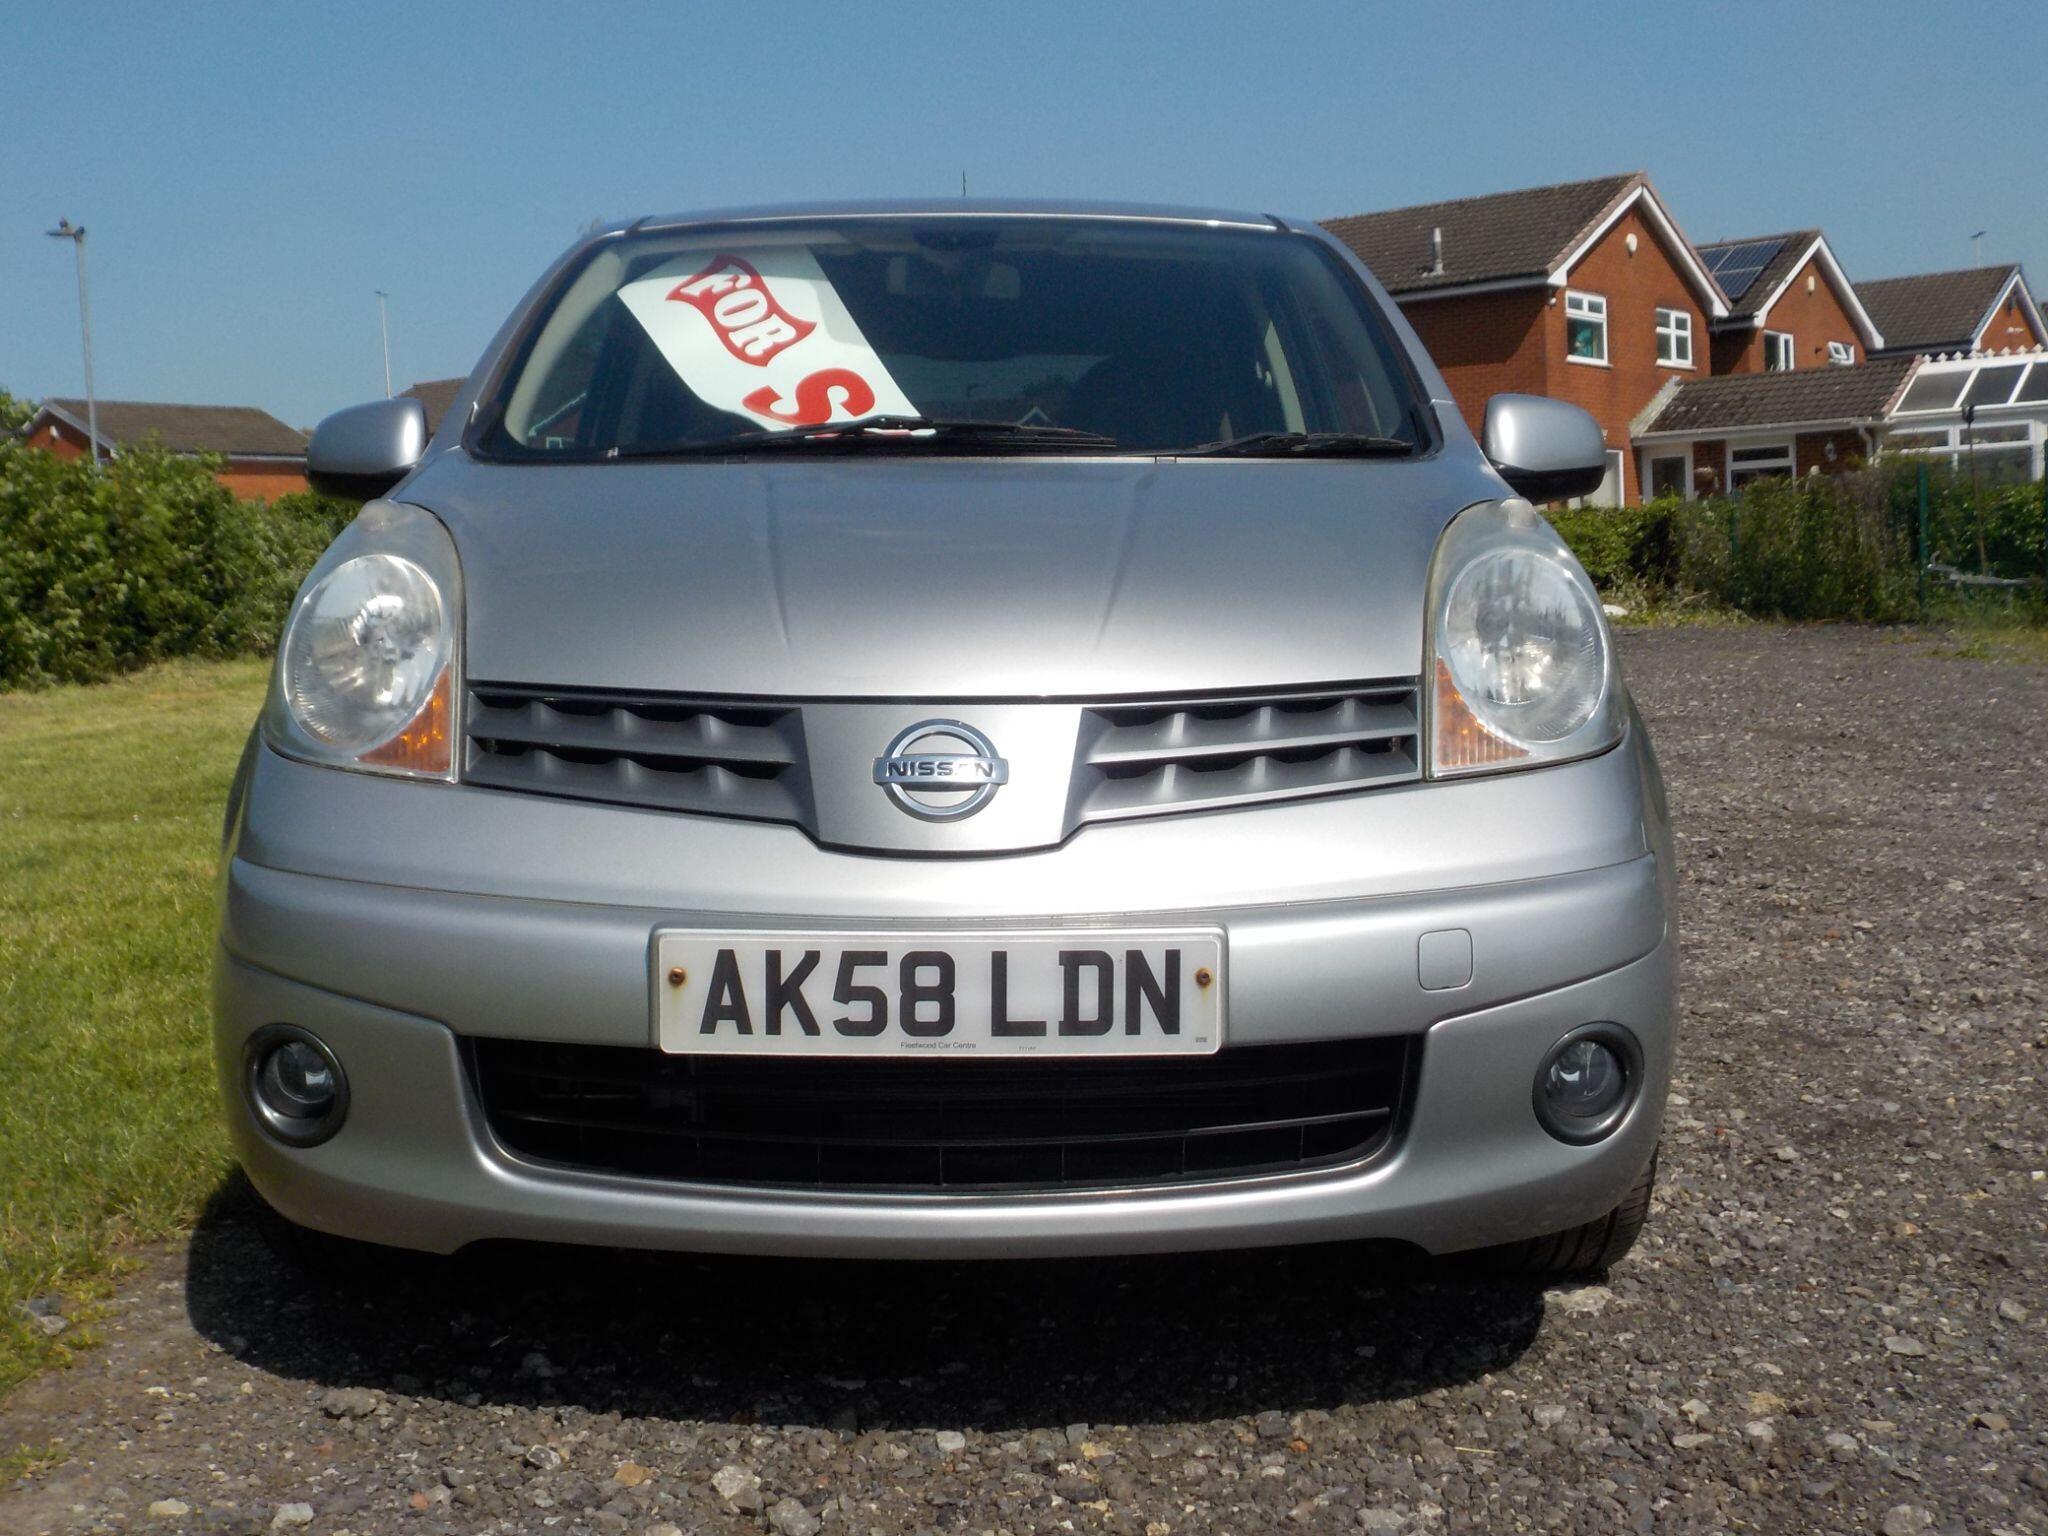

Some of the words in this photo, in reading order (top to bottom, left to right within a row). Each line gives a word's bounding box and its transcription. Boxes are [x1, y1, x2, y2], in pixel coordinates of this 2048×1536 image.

[680, 264, 797, 357] FOR
[886, 760, 995, 778] NISSN
[700, 949, 956, 1037] AK58
[991, 949, 1181, 1037] LDN
[900, 1041, 937, 1049] Fleetwood
[938, 1041, 951, 1049] Car
[952, 1041, 977, 1049] Centre
